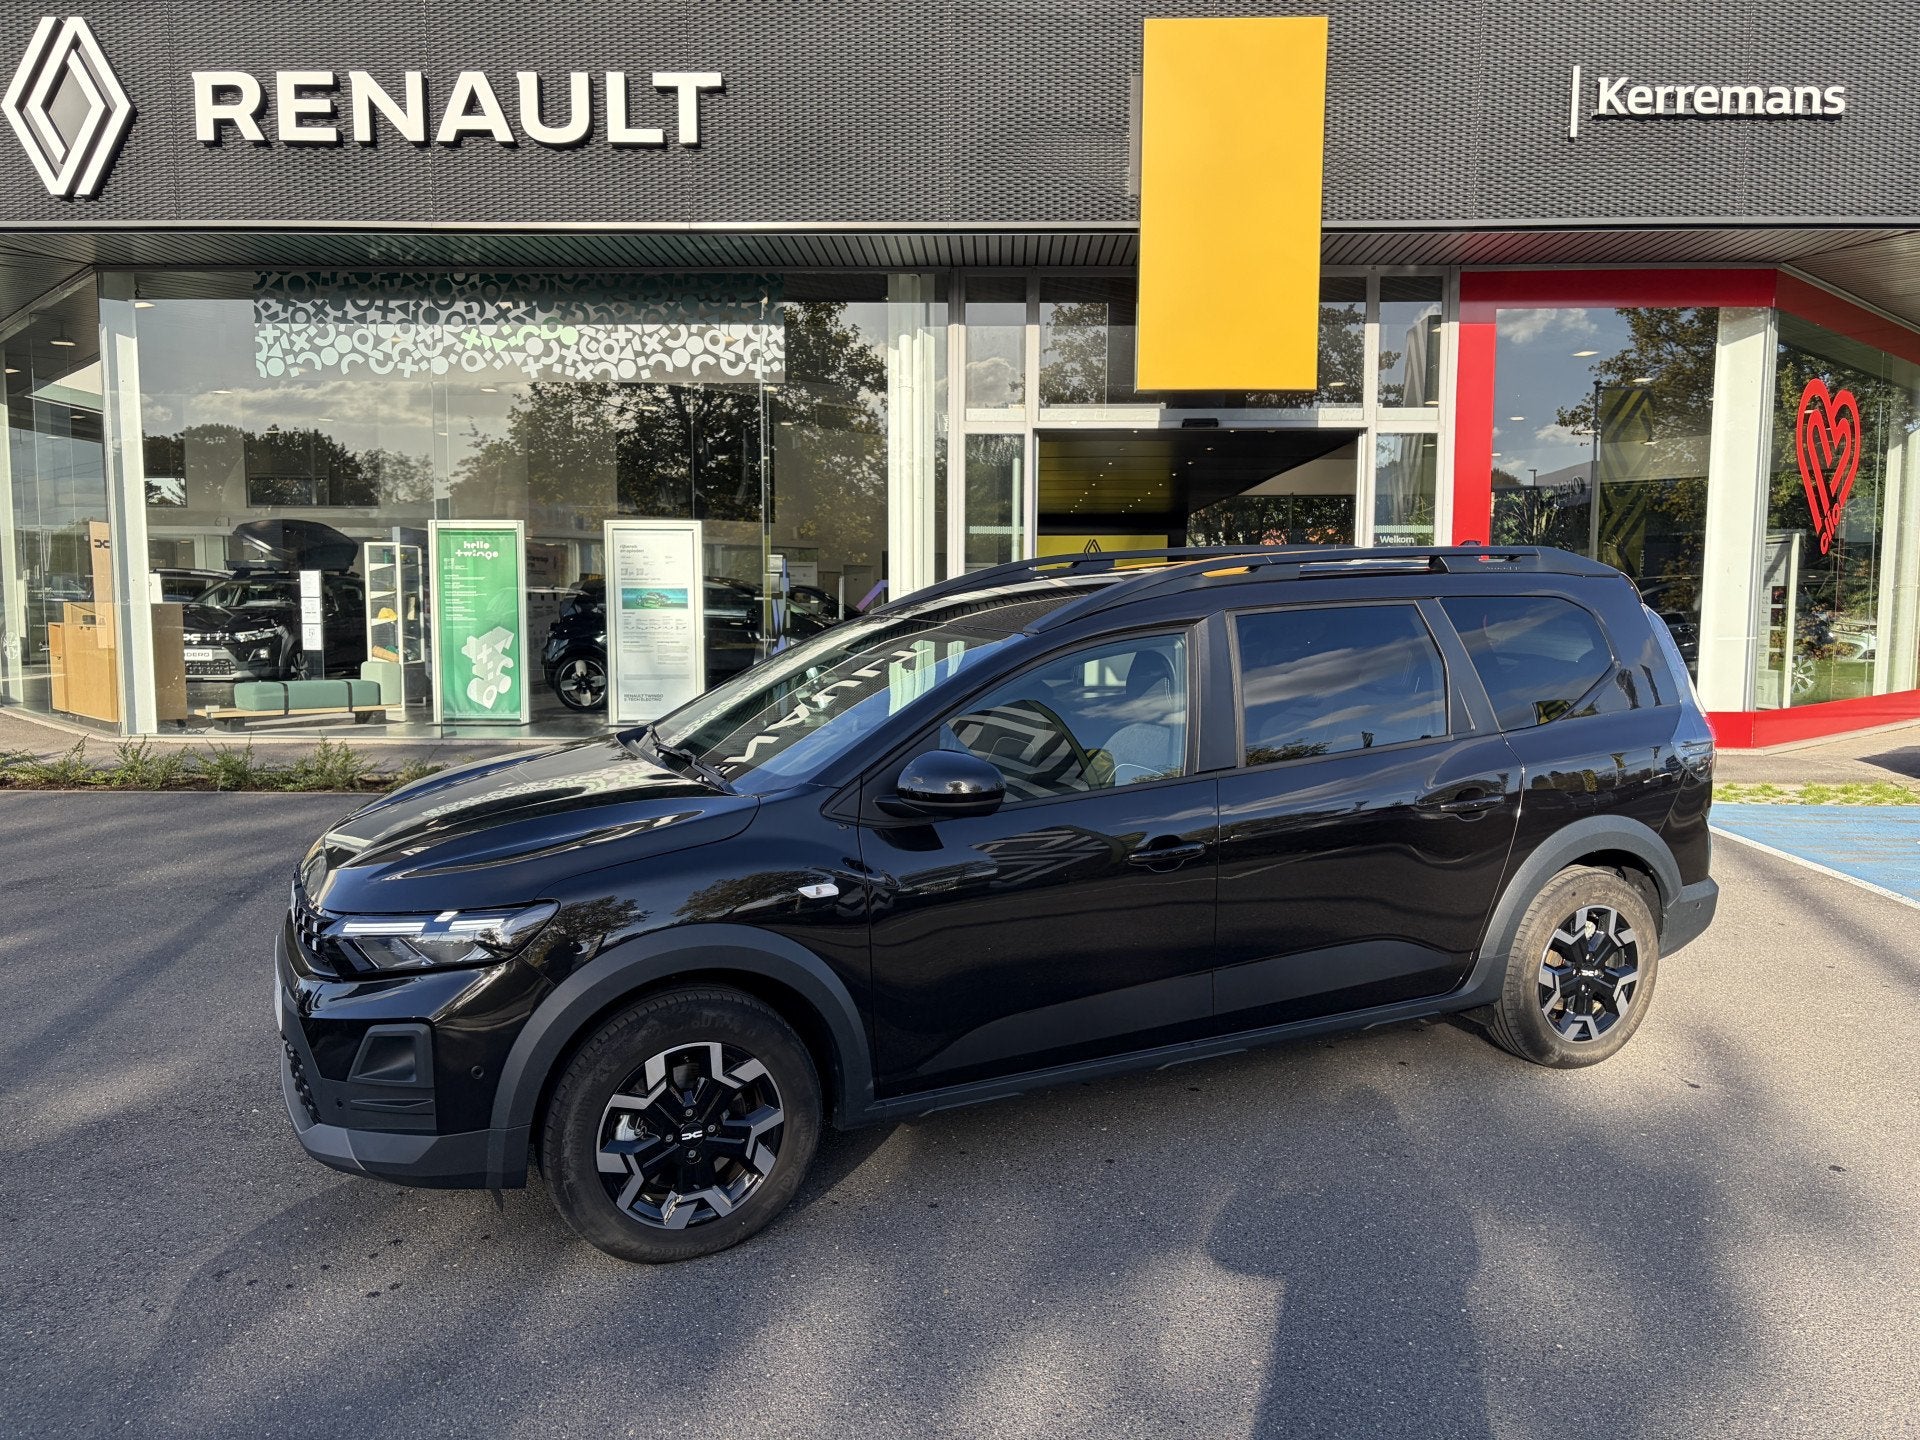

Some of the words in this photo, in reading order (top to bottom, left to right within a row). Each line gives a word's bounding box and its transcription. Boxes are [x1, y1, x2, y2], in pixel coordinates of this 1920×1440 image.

[192, 70, 724, 148] RENAULT
[1597, 76, 1846, 116] Kerremans
[463, 540, 491, 549] hello
[1379, 535, 1415, 544] Welkom
[1820, 503, 1841, 555] clio
